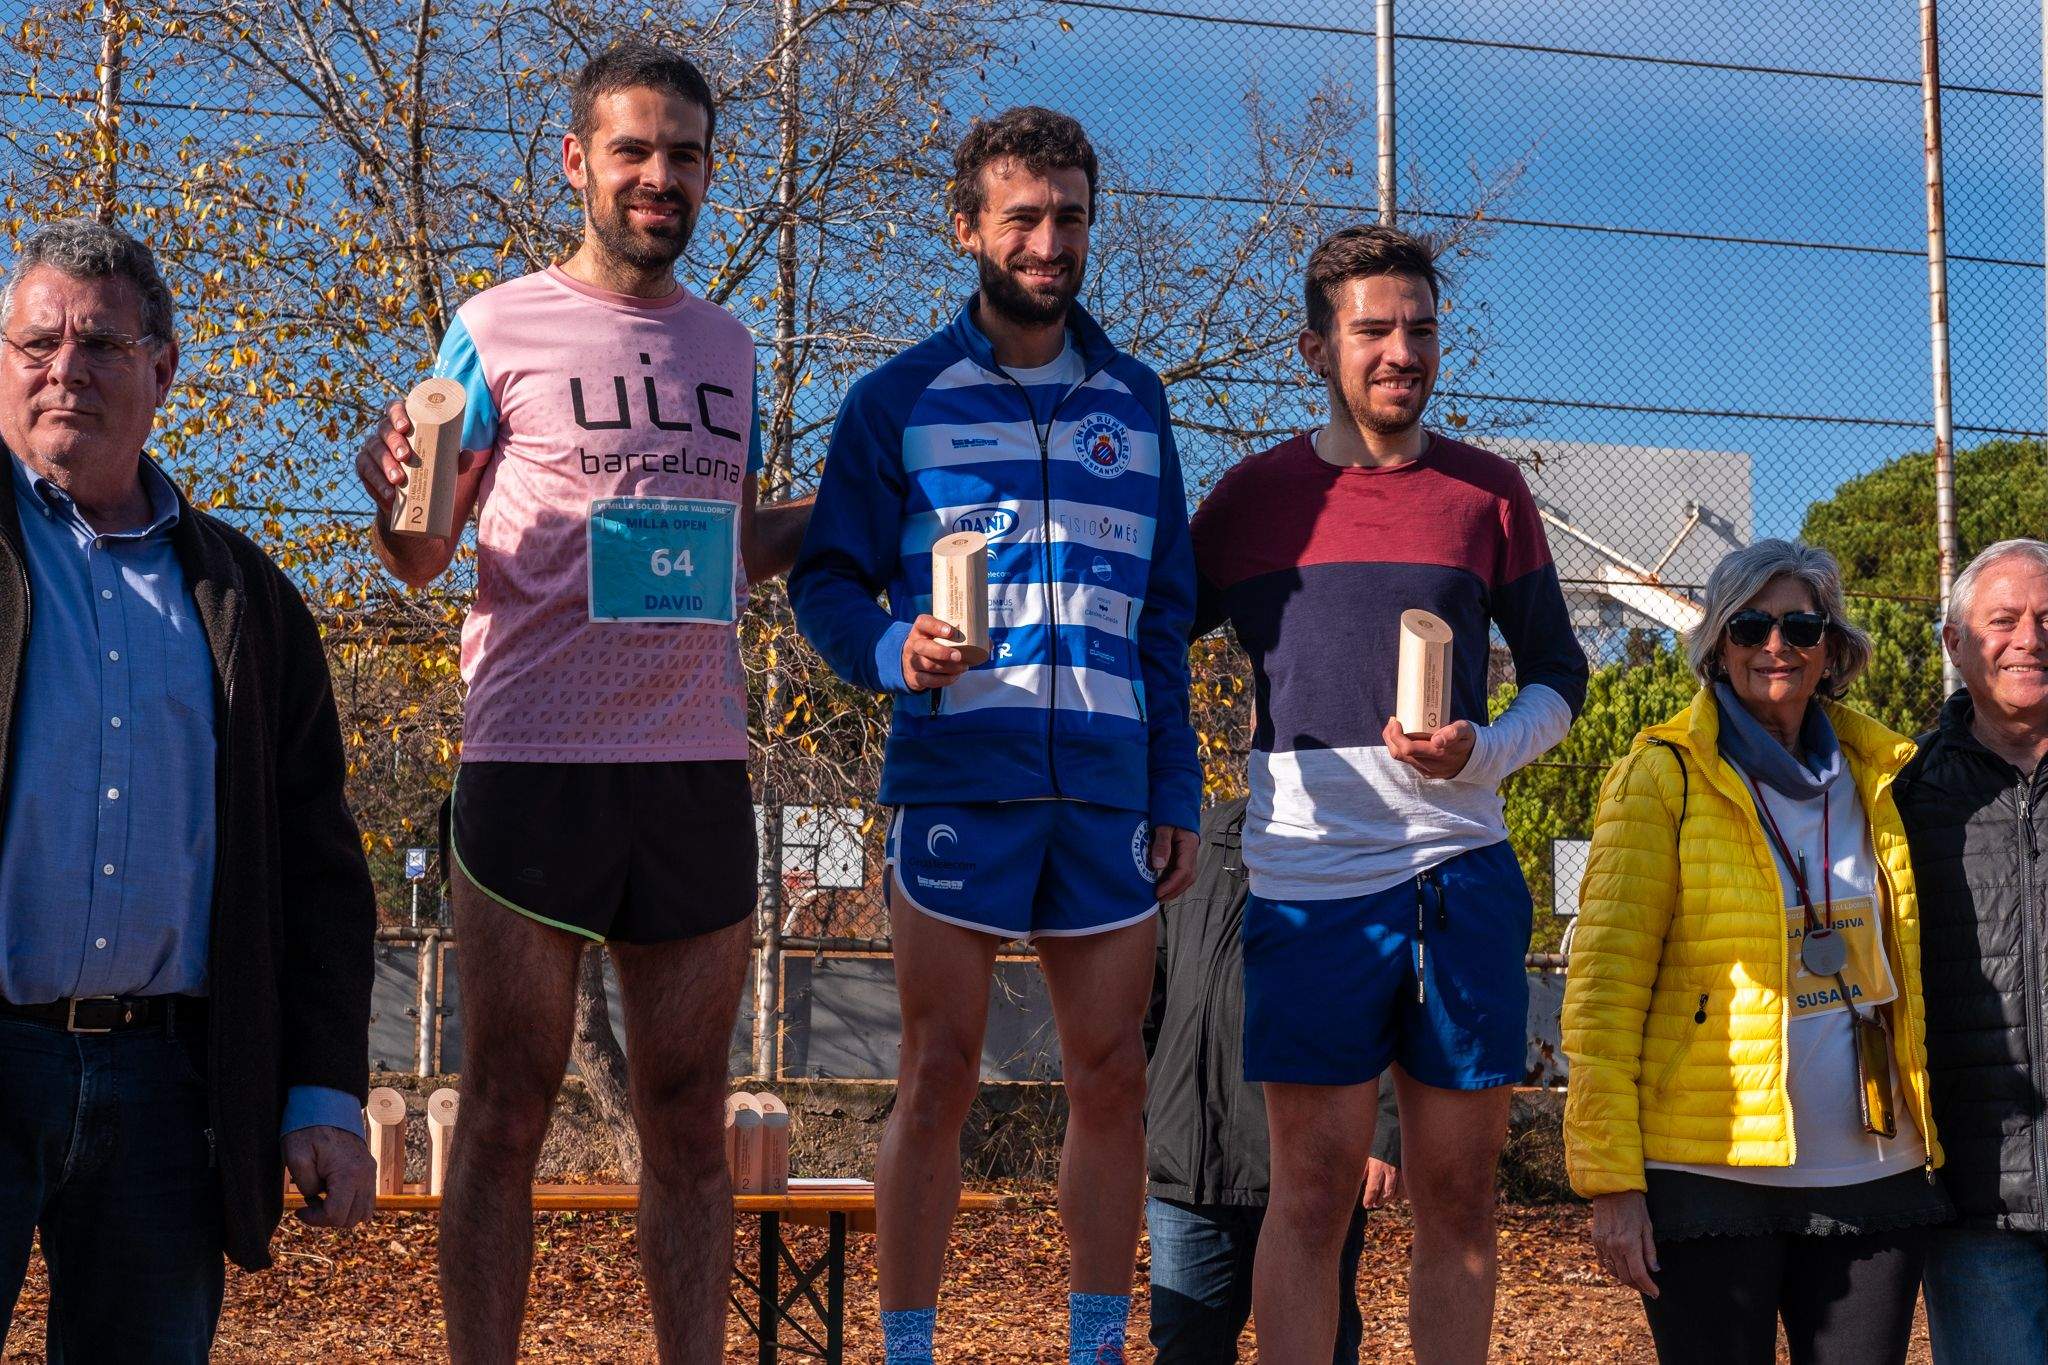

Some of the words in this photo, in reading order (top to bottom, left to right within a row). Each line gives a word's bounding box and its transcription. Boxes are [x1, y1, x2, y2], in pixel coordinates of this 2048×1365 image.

[570, 353, 741, 442] uic
[1075, 419, 1094, 453] PENYA
[1096, 415, 1130, 461] RUNNERS
[580, 448, 740, 483] barcelona
[1083, 457, 1123, 475] ESPANYOL
[411, 506, 423, 524] 2
[679, 504, 689, 512] DE
[627, 518, 669, 530] MILLA
[673, 519, 708, 531] OPEN
[959, 515, 1006, 534] DANI
[651, 549, 694, 577] 64
[644, 594, 703, 611] DAVID
[1427, 712, 1437, 728] 3
[1796, 984, 1863, 1009] SUSAA
[742, 1178, 750, 1190] 2
[774, 1178, 781, 1190] 3
